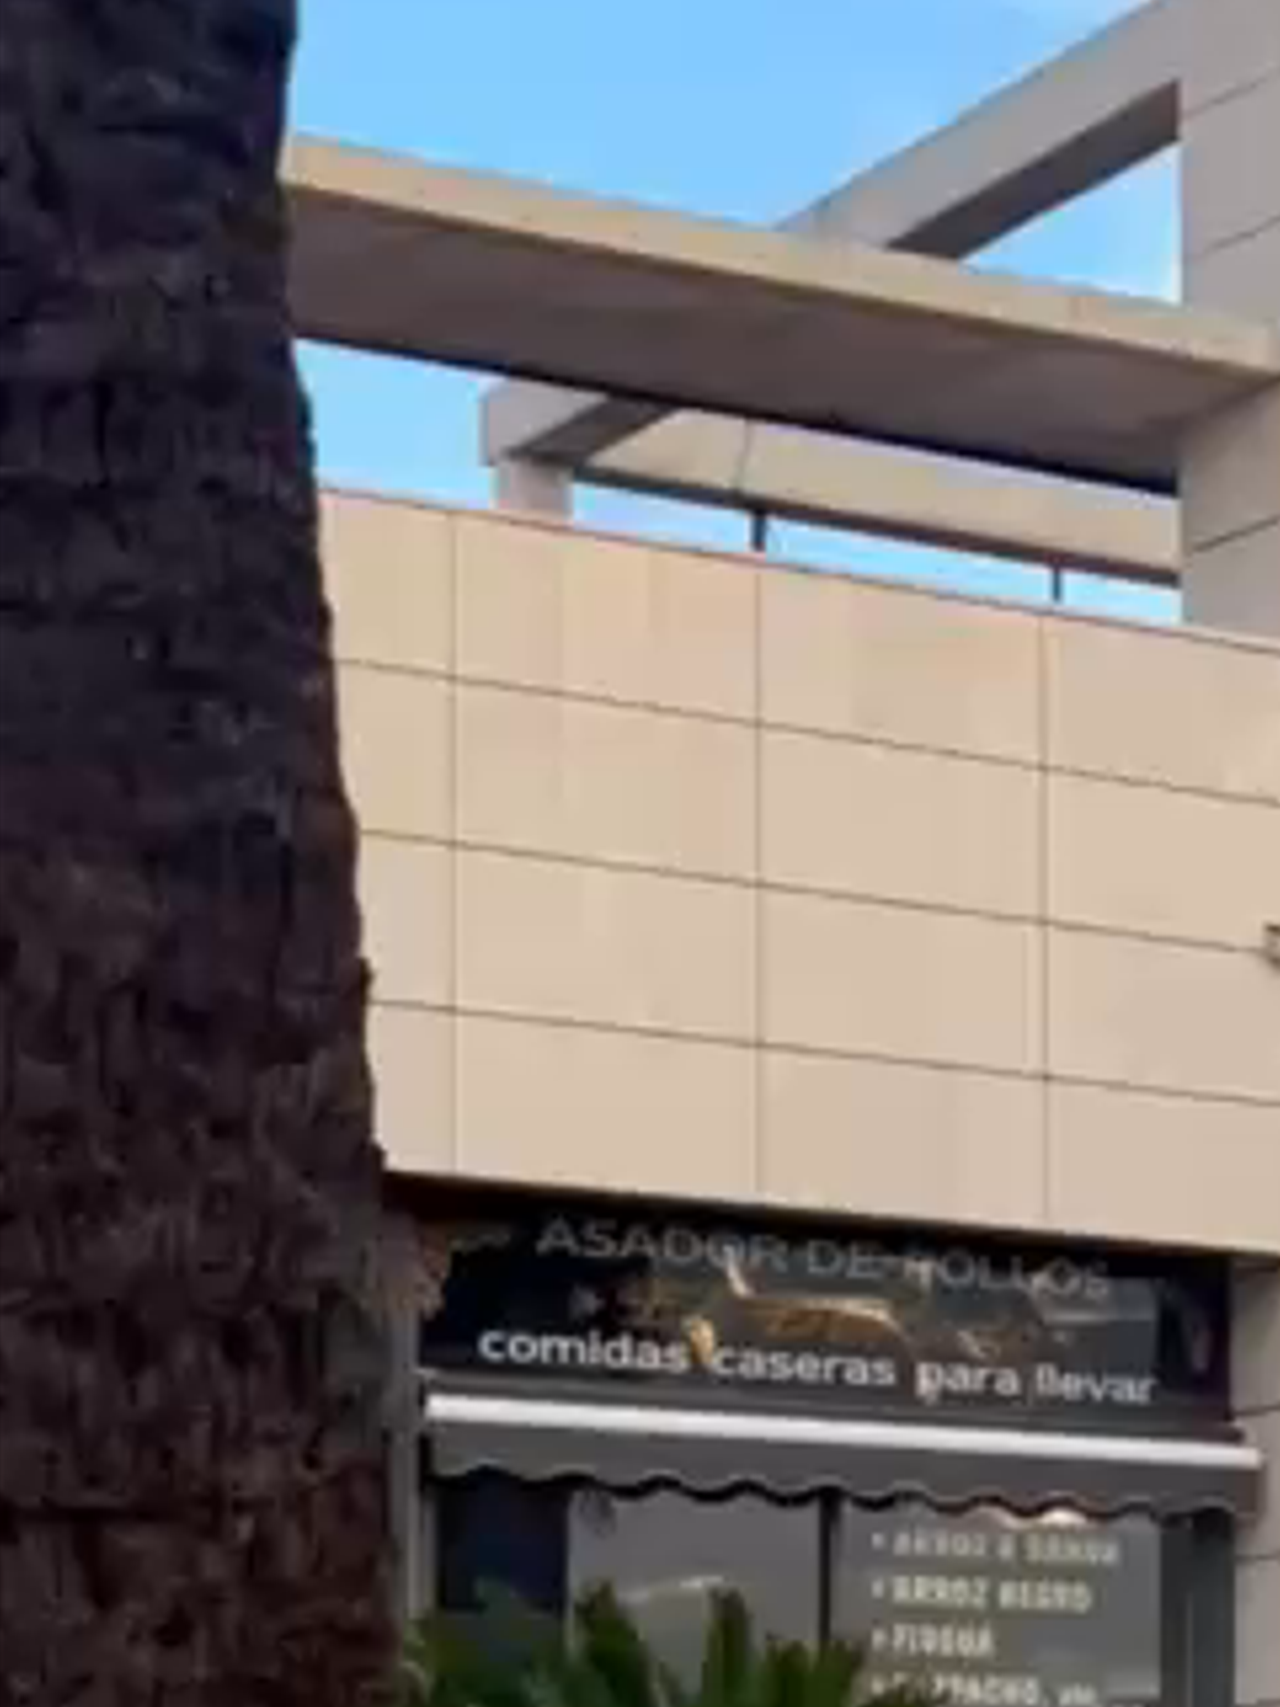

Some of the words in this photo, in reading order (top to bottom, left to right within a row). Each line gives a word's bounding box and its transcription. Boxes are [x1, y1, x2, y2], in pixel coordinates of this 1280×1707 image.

[535, 1213, 790, 1274] ASADOR
[807, 1239, 884, 1279] DE
[476, 1328, 690, 1374] comidas
[713, 1345, 896, 1385] caseras
[914, 1361, 1021, 1406] para
[1035, 1361, 1156, 1403] llevar
[893, 1575, 988, 1610] ARROZ
